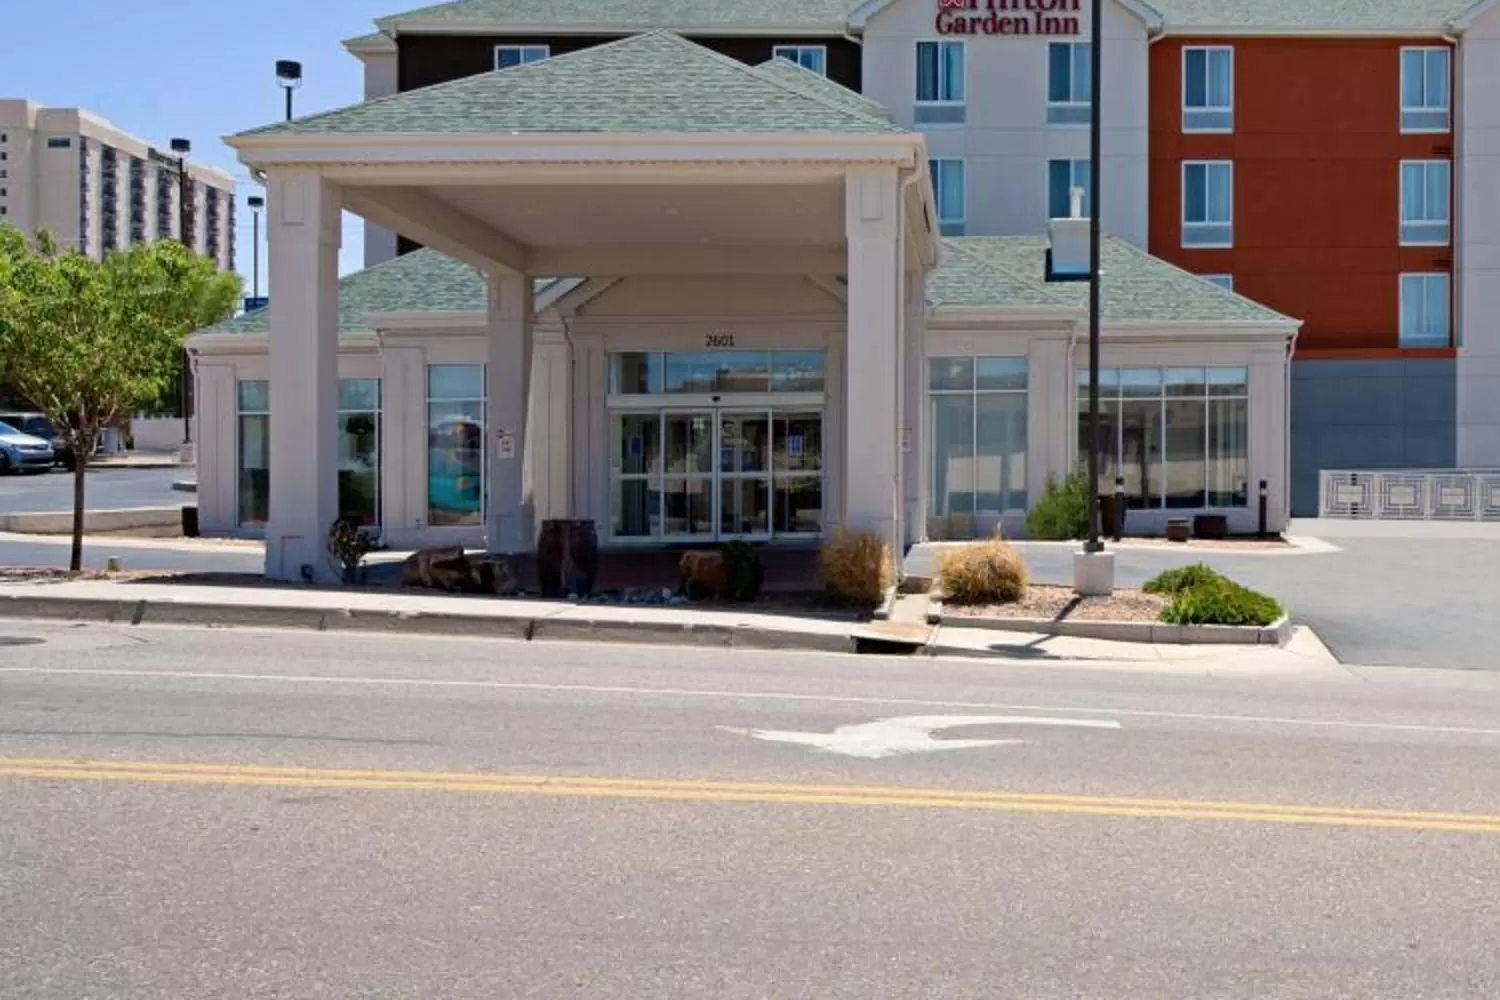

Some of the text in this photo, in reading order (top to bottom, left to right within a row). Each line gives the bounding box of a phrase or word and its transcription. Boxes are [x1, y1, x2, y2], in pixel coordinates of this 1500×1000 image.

[935, 12, 1080, 35] Garden Inn
[704, 335, 735, 347] 2601
